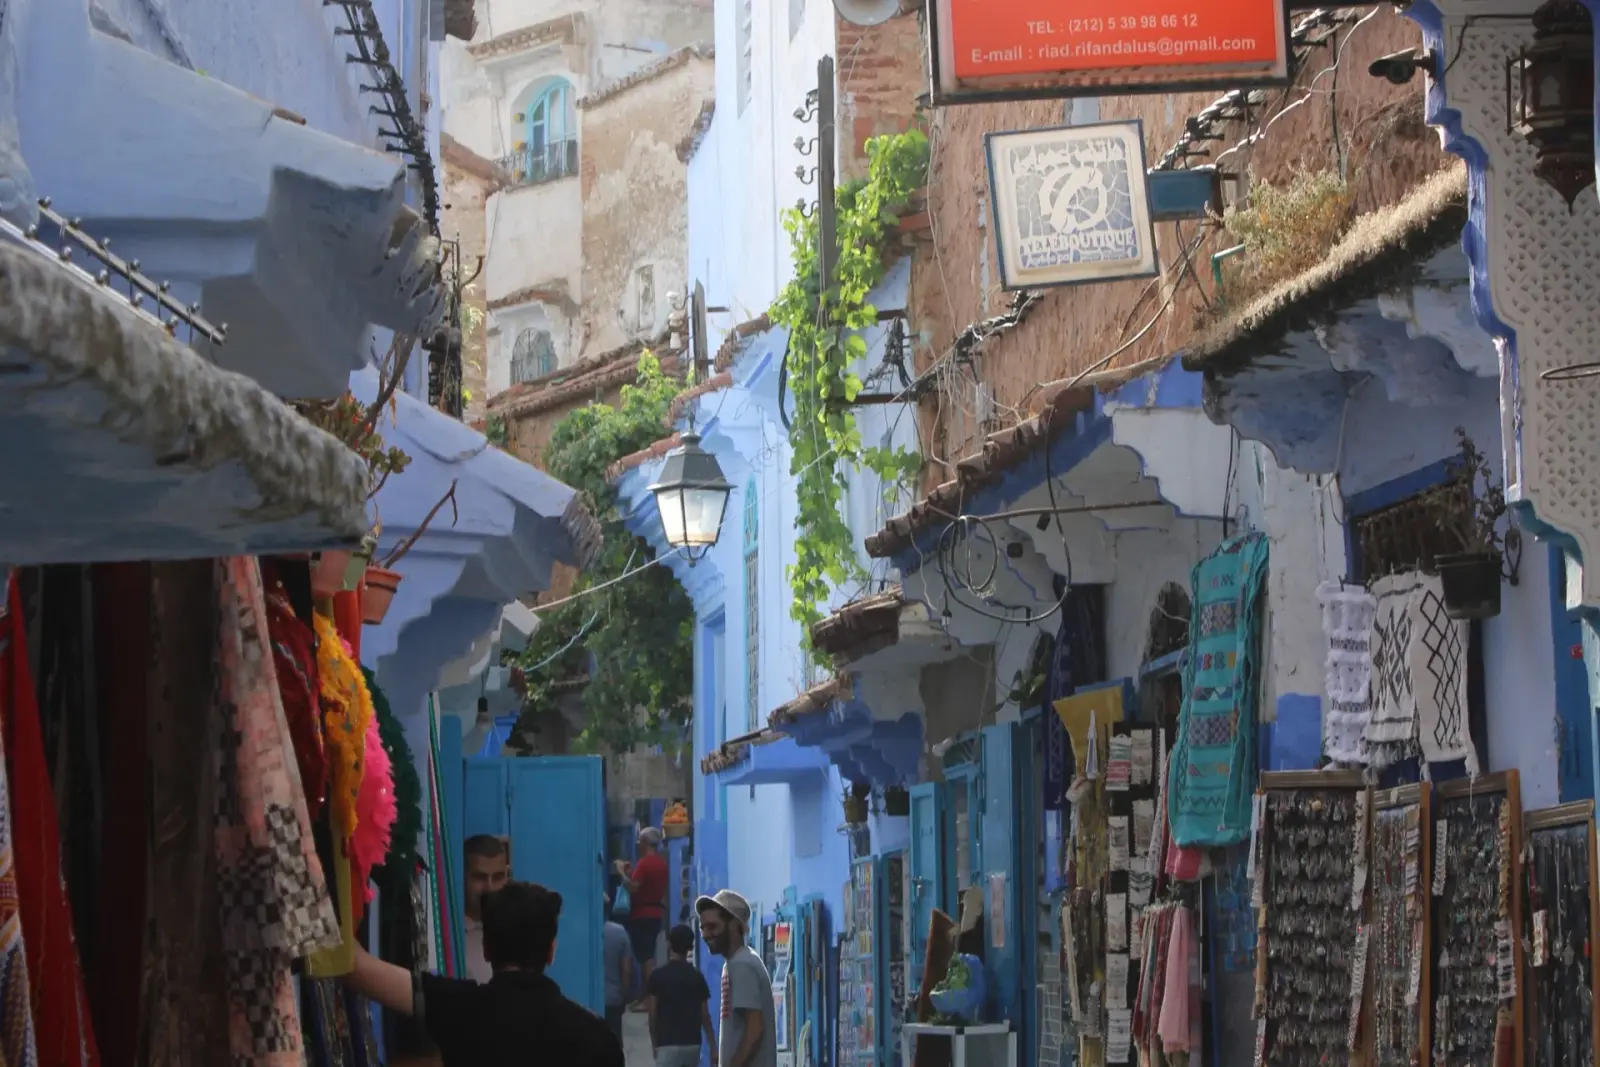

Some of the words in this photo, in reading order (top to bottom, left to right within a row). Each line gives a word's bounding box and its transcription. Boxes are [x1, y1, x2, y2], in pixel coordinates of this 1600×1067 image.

[1027, 20, 1055, 34] TEL
[1068, 18, 1103, 35] (212)
[1108, 17, 1116, 30] 5
[1120, 16, 1137, 29] 39
[1140, 15, 1157, 28] 98
[1161, 14, 1178, 27] 66
[1182, 13, 1198, 27] 12
[971, 44, 1023, 63] E-mail
[1038, 35, 1257, 59] riad.rifandalus@gmail.com
